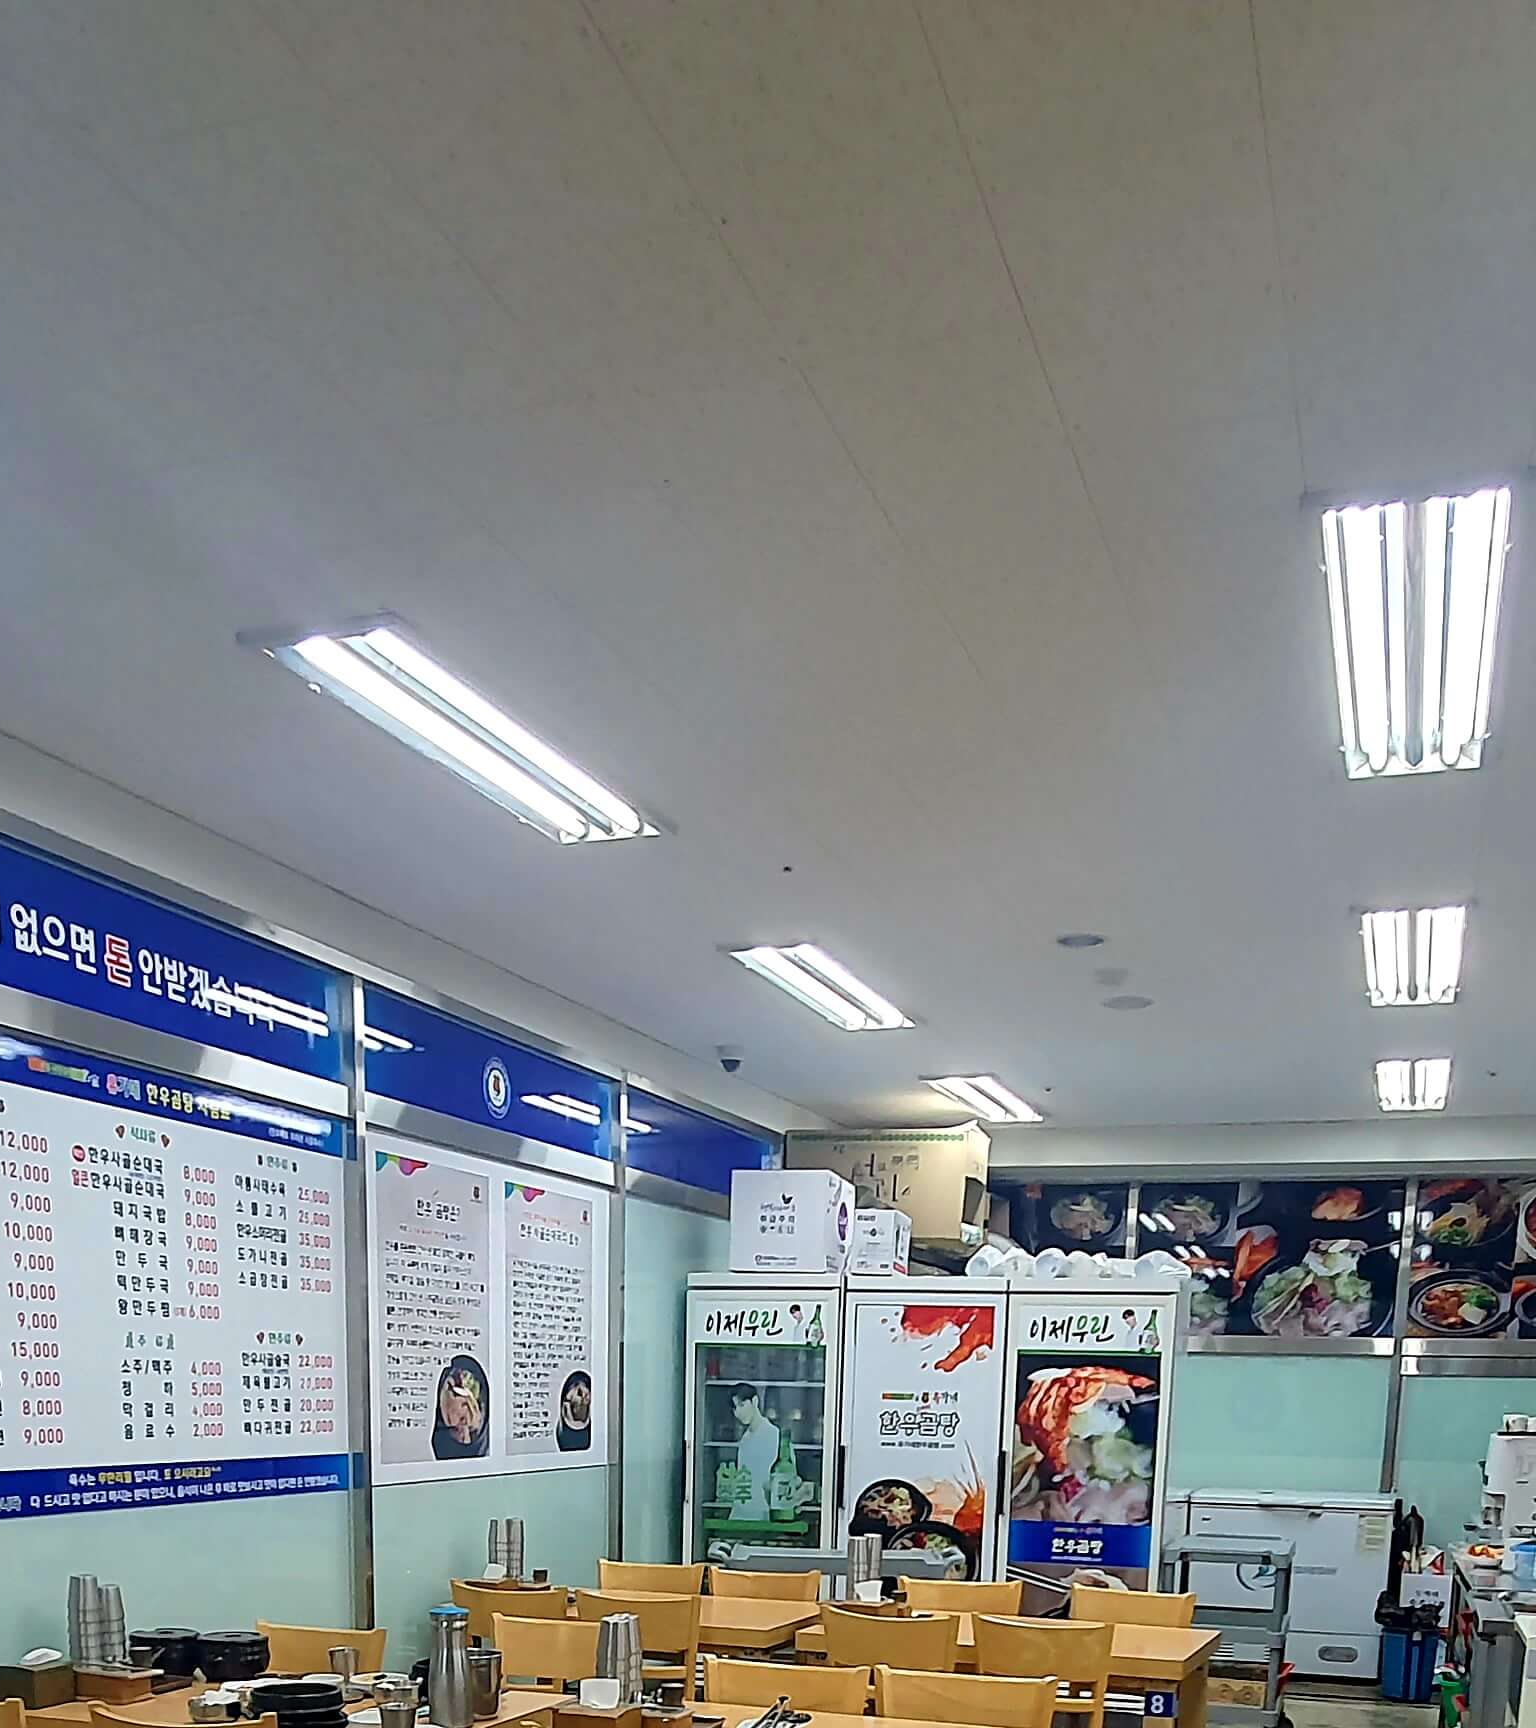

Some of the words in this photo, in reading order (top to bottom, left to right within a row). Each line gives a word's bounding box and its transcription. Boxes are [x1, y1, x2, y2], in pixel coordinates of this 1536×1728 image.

[10, 903, 97, 975] 없으면
[104, 933, 133, 988] 돈
[146, 1082, 194, 1114] 한우곰탕
[0, 1161, 50, 1184] 12,000
[88, 1146, 163, 1175] 한우사골순대국
[183, 1165, 216, 1184] 8,000
[10, 1191, 52, 1213] 9,000
[184, 1188, 216, 1207] 9,000
[184, 1211, 217, 1230] 8,000
[3, 1221, 54, 1243] 10,000
[186, 1235, 218, 1252] 9,000
[13, 1253, 55, 1272] 9,000
[187, 1258, 218, 1275] 9,000
[7, 1282, 57, 1301] 10,000
[188, 1280, 219, 1297] 9,000
[17, 1312, 58, 1330] 9,000
[188, 1304, 220, 1320] 6,000
[705, 1309, 783, 1337] 이제우린
[1030, 1315, 1114, 1343] 이제우린
[10, 1342, 60, 1359] 15,000
[191, 1361, 222, 1376] 4,000
[20, 1370, 61, 1388] 9,000
[191, 1382, 222, 1398] 5,000
[22, 1399, 63, 1417] 8,000
[193, 1423, 223, 1439] 2,000
[880, 1410, 960, 1438] 한우곰탕
[24, 1428, 64, 1446] 9,000
[1150, 1694, 1165, 1714] 8
